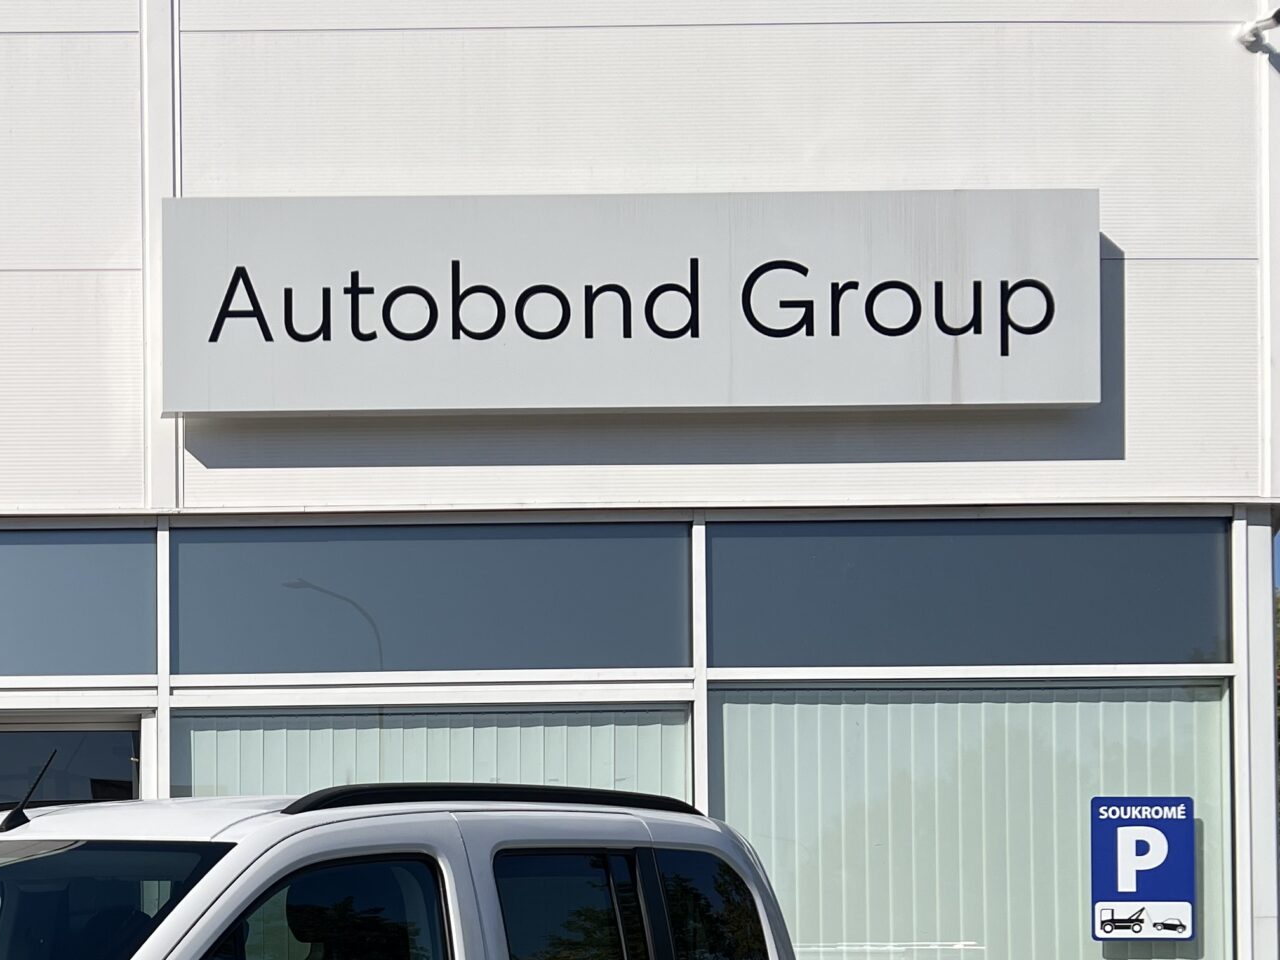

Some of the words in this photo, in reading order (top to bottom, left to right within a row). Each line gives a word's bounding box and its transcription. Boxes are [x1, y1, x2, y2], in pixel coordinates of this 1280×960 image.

[209, 257, 702, 344] Autobond
[740, 259, 1056, 357] Group
[1098, 803, 1187, 819] SOUKROMÉ
[1116, 825, 1169, 893] P
